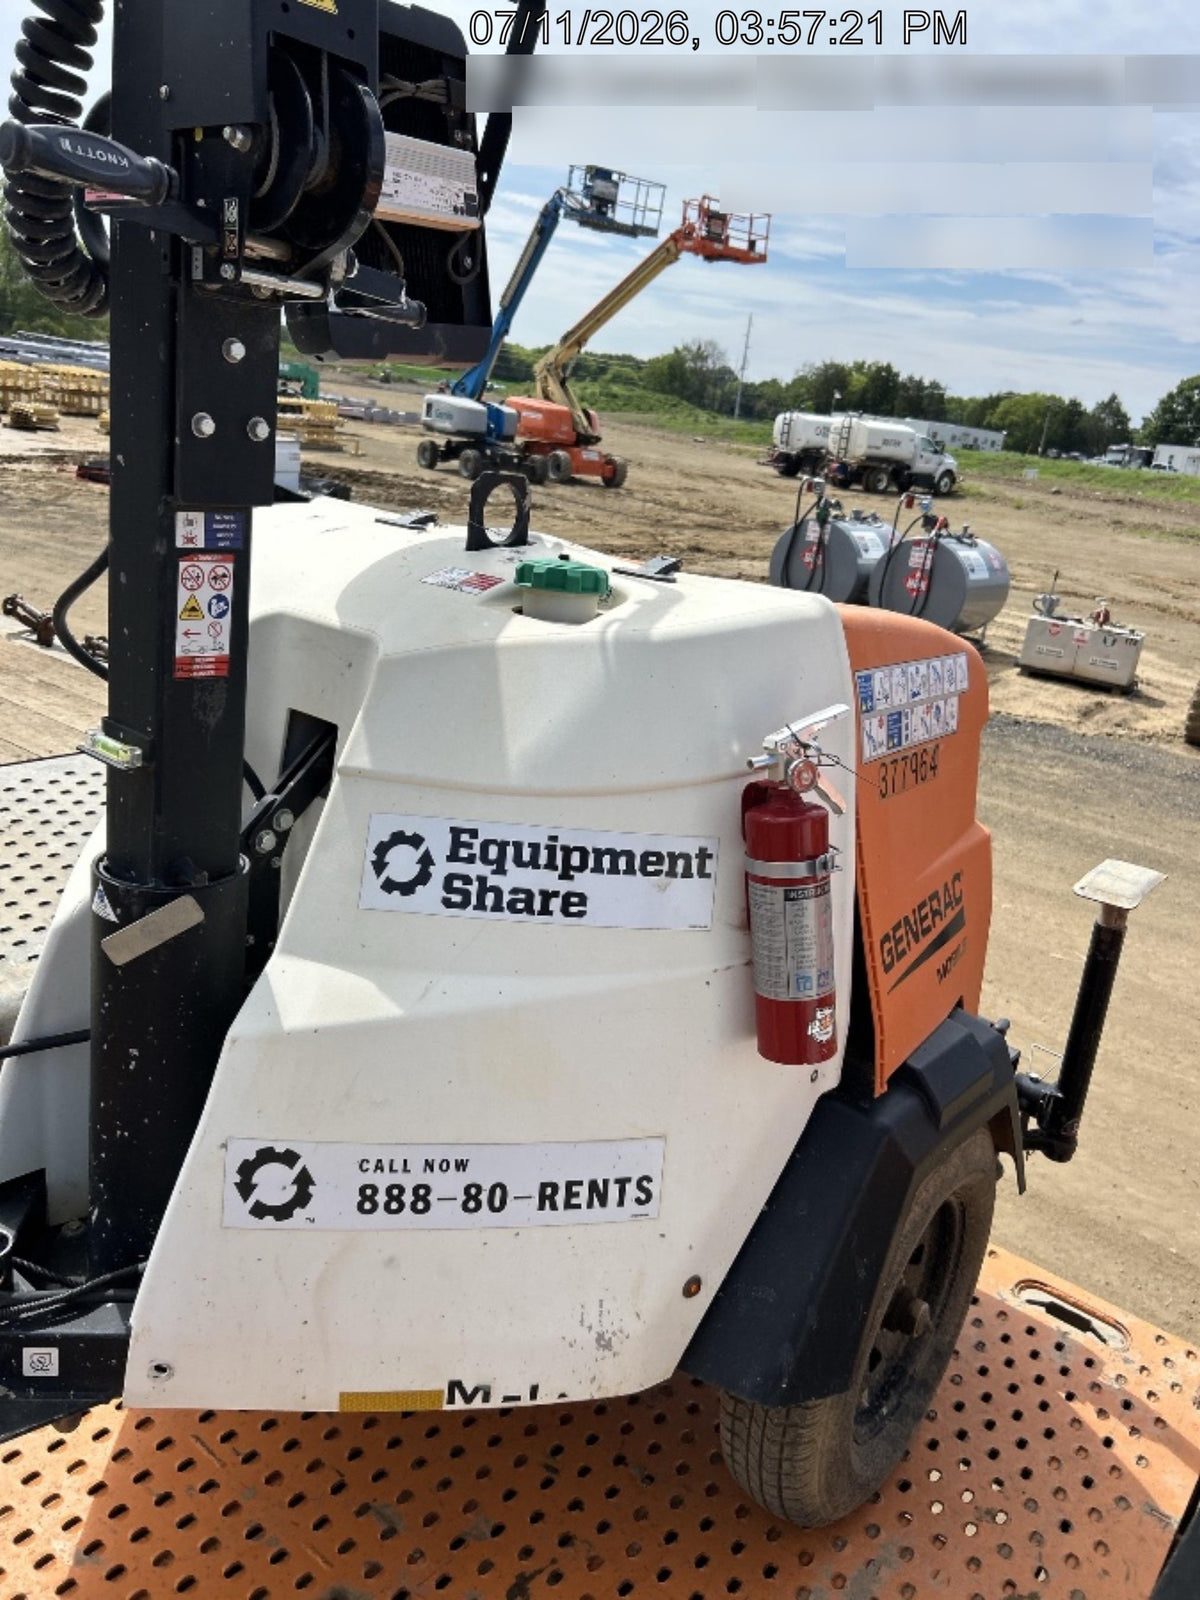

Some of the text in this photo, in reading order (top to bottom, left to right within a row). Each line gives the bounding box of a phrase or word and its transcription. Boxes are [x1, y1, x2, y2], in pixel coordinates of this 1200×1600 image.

[75, 145, 129, 168] KNOTT
[879, 744, 940, 799] 377964
[446, 826, 714, 881] Equipment
[441, 872, 588, 918] Share
[880, 869, 964, 975] GENERAC
[358, 1158, 470, 1174] CALL NOW
[356, 1174, 655, 1216] 888-80-RENTS
